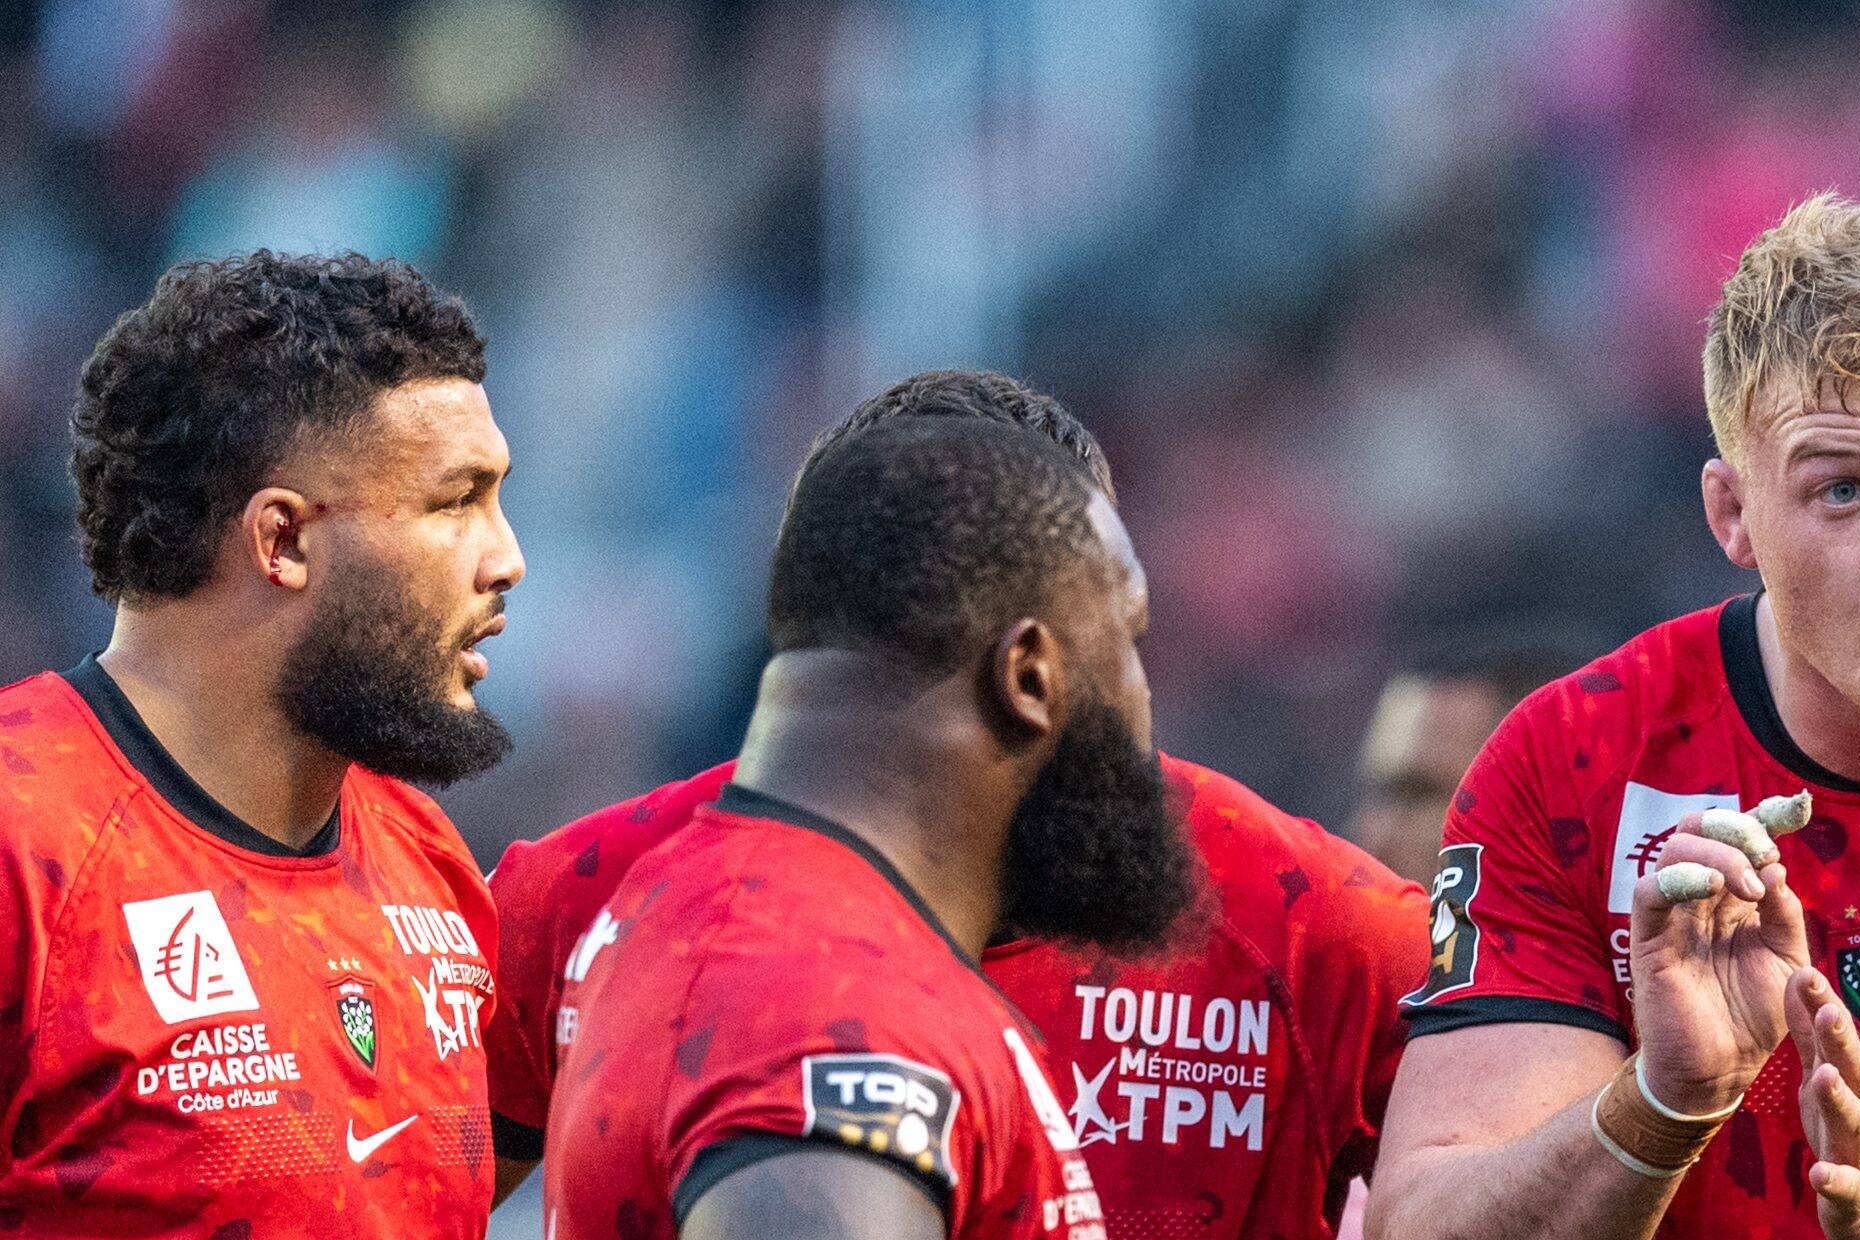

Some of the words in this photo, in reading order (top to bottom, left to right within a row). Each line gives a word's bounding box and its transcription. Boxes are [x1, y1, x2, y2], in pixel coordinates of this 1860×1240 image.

[1075, 984, 1270, 1055] TOULON
[170, 1024, 270, 1059] CAISSE
[137, 1053, 301, 1095] D'EPARGNE
[1119, 1046, 1267, 1088] MÉTROPOLE
[177, 1089, 225, 1114] Côte
[227, 1088, 279, 1109] d'Azur
[825, 1071, 939, 1118] TOP
[1117, 1081, 1265, 1151] TPM
